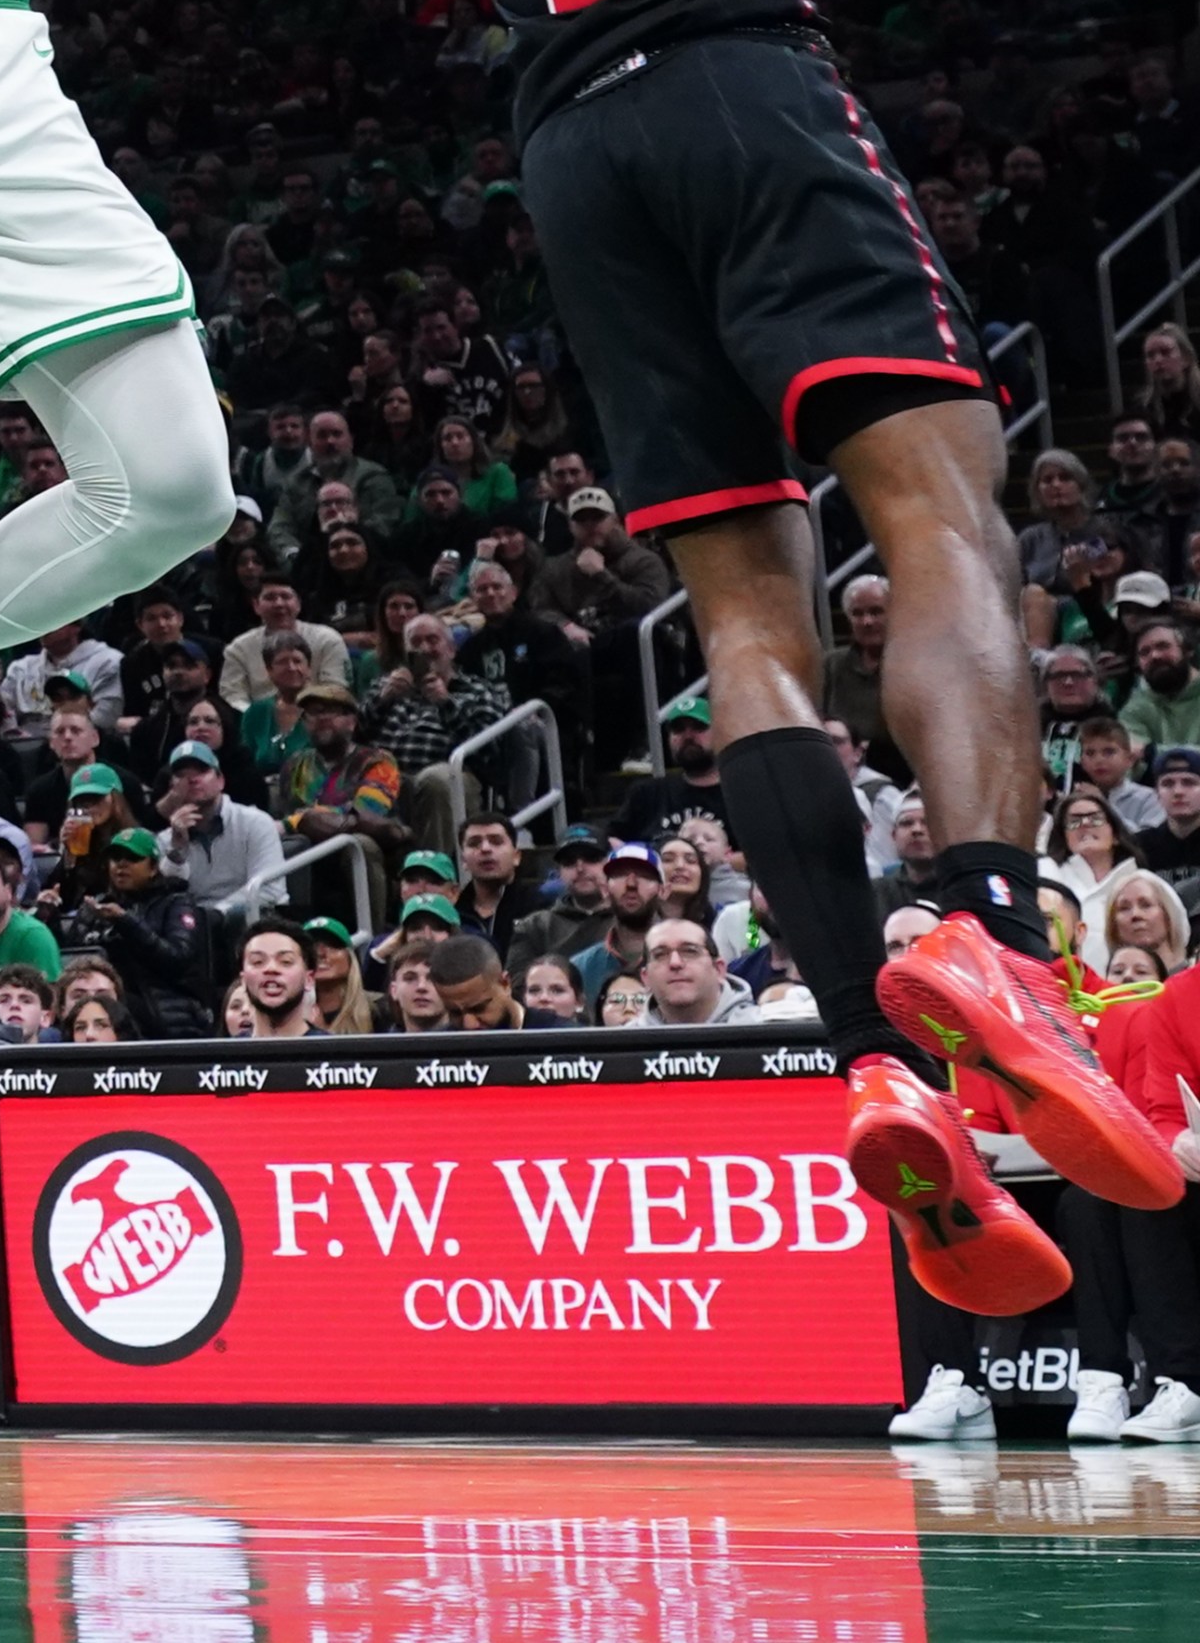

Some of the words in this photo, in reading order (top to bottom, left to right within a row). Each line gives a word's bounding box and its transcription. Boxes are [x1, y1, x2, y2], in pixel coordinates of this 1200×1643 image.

[416, 1059, 489, 1087] xfinity
[528, 1056, 603, 1083] xfinity
[643, 1052, 721, 1080] xfinity
[762, 1047, 837, 1075] xfinity
[93, 1066, 161, 1093] xfinity
[198, 1064, 269, 1091] xfinity
[305, 1062, 378, 1089] xfinity
[265, 1161, 461, 1256] F.W.
[493, 1154, 868, 1255] WEBB
[82, 1202, 192, 1294] WEBB
[403, 1278, 722, 1331] COMPANY
